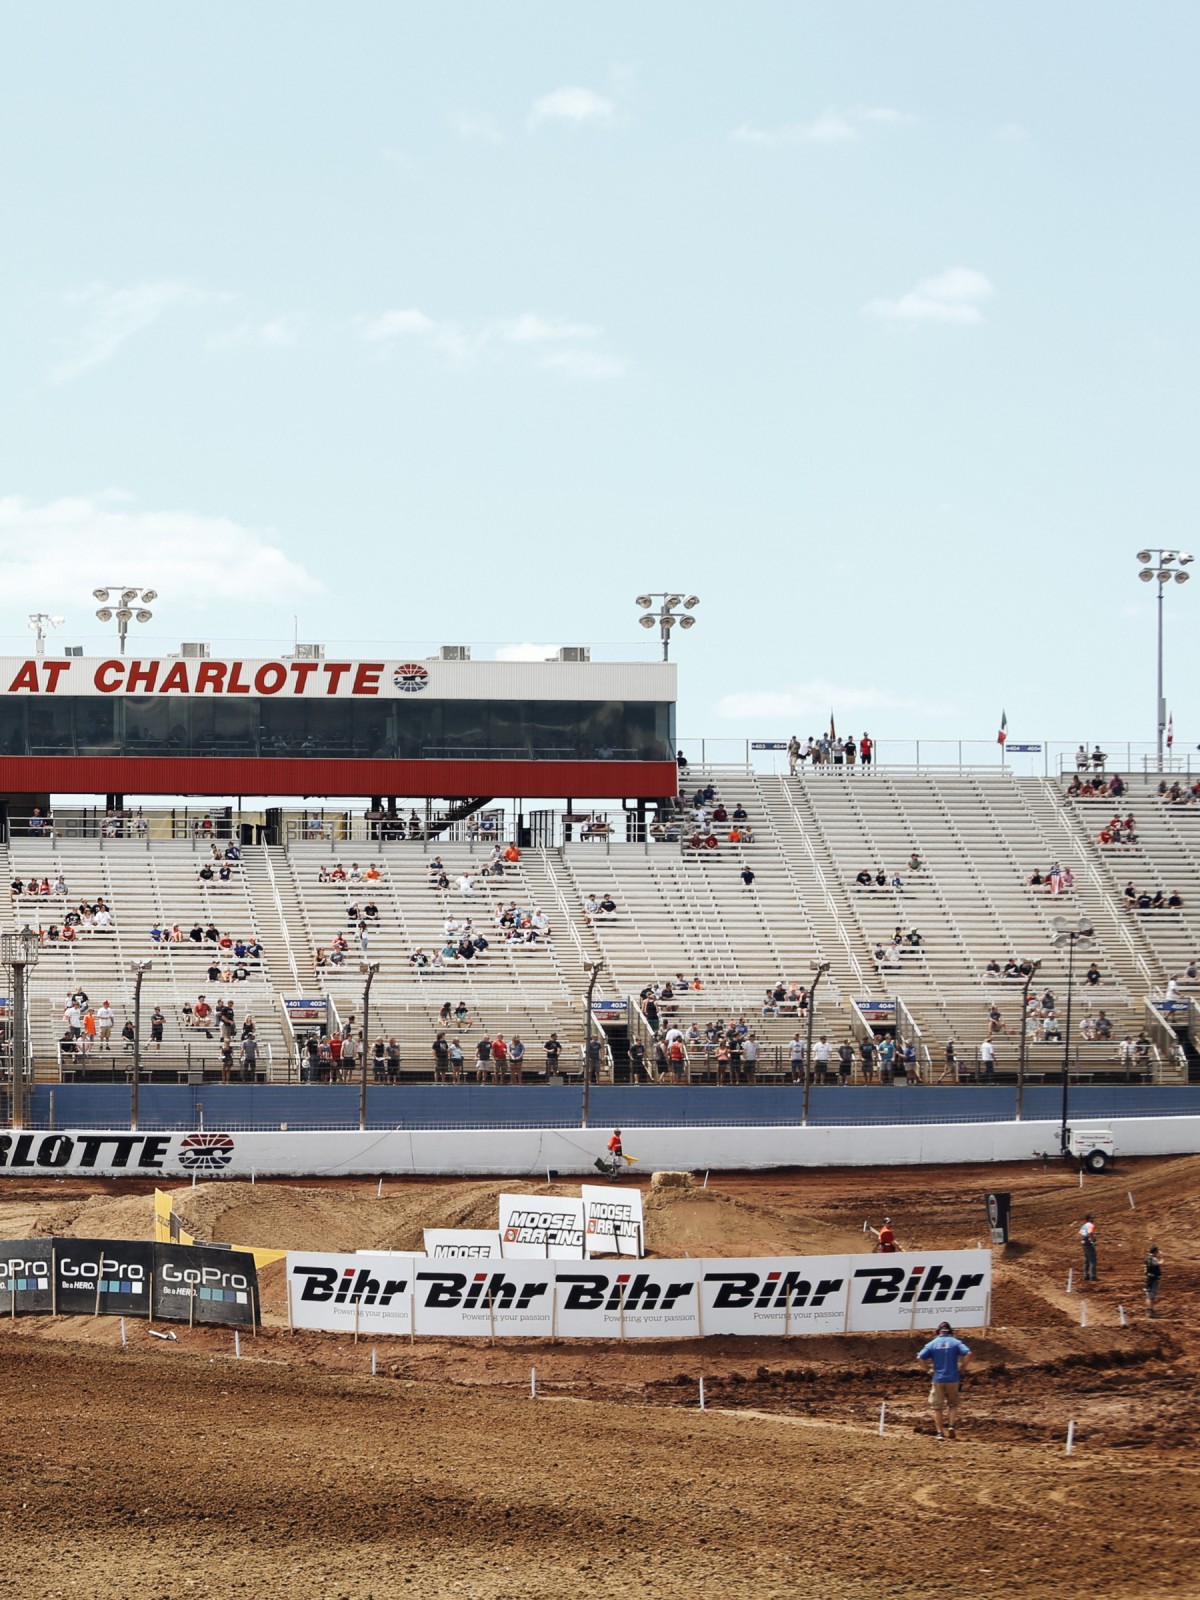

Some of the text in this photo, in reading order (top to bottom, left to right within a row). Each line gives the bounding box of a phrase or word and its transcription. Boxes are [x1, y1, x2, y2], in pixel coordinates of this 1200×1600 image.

[8, 660, 70, 692] AT
[93, 660, 385, 695] CHARLOTTE
[508, 1211, 575, 1229] MOOSE
[590, 1202, 631, 1221] MOOSE
[516, 1228, 583, 1246] RACING
[434, 1245, 491, 1258] MOOSE
[60, 1258, 143, 1279] GoPro
[162, 1263, 247, 1289] GoPro
[62, 1280, 70, 1289] Be
[163, 1286, 171, 1294] Be
[293, 1266, 408, 1305] Bihr
[416, 1272, 548, 1309] Bihr
[555, 1274, 694, 1310] Bihr
[704, 1271, 843, 1308] Bihr
[853, 1265, 984, 1304] Bihr
[365, 1310, 381, 1318] your
[382, 1310, 408, 1319] passion
[520, 1313, 550, 1322] passion
[643, 1315, 662, 1323] your
[664, 1313, 696, 1323] passion
[793, 1312, 812, 1320] your
[814, 1311, 844, 1320] passion
[935, 1306, 953, 1315] your
[955, 1304, 984, 1314] passion
